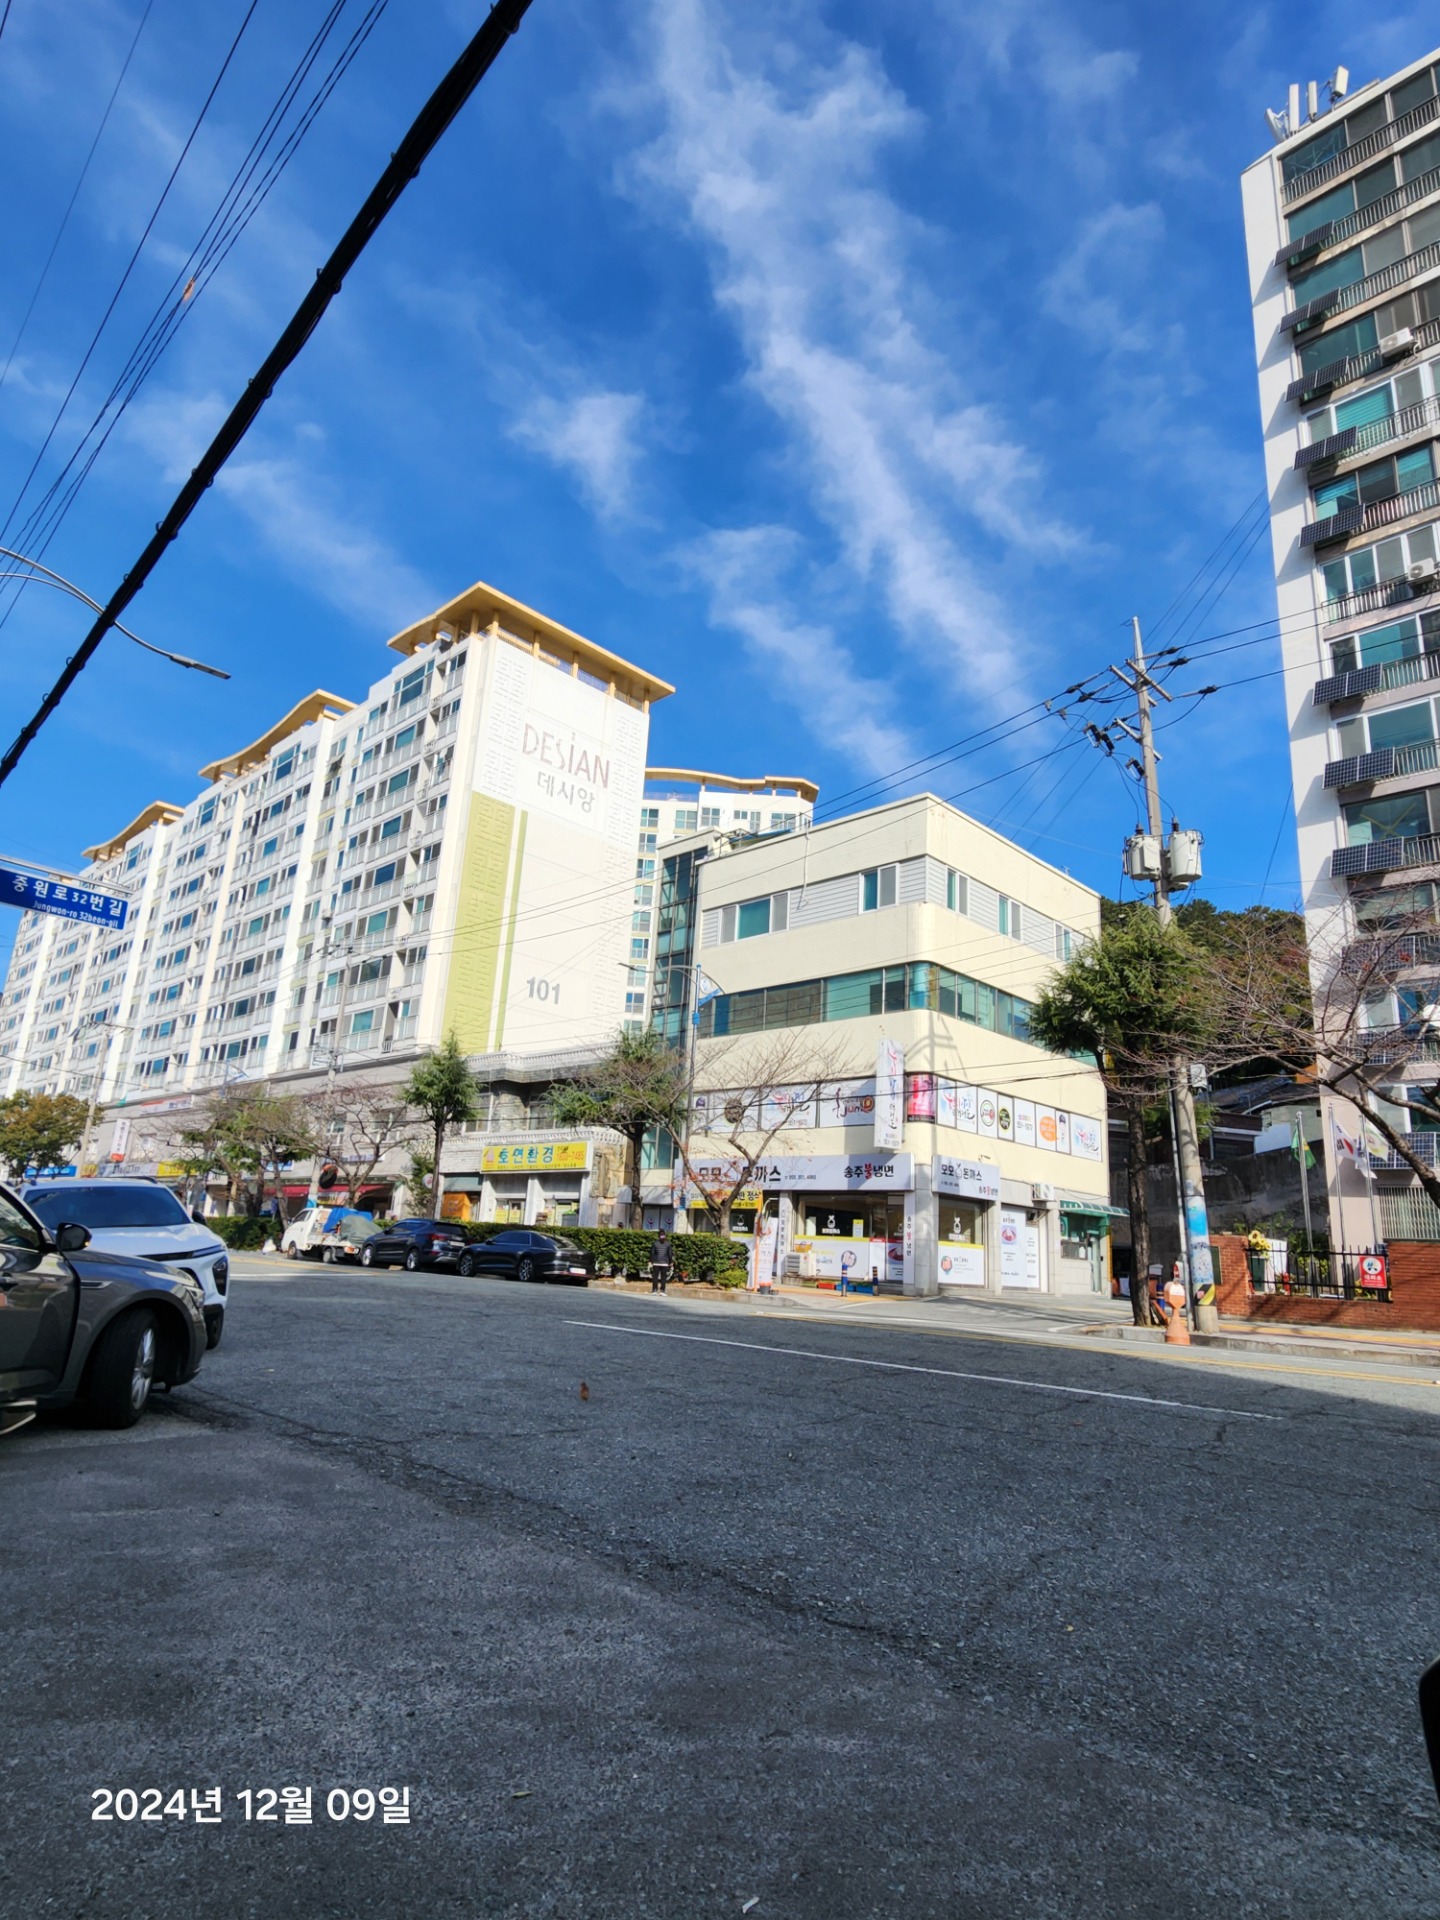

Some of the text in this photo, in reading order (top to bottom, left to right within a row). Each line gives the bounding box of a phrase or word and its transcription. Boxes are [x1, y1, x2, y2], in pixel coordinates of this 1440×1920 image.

[537, 771, 595, 813] 데시앙
[32, 900, 119, 928] Jungwon-ro 32beon-gil
[526, 977, 561, 1004] 101
[844, 1163, 894, 1179] 송주불냉면
[941, 1164, 954, 1176] 모모
